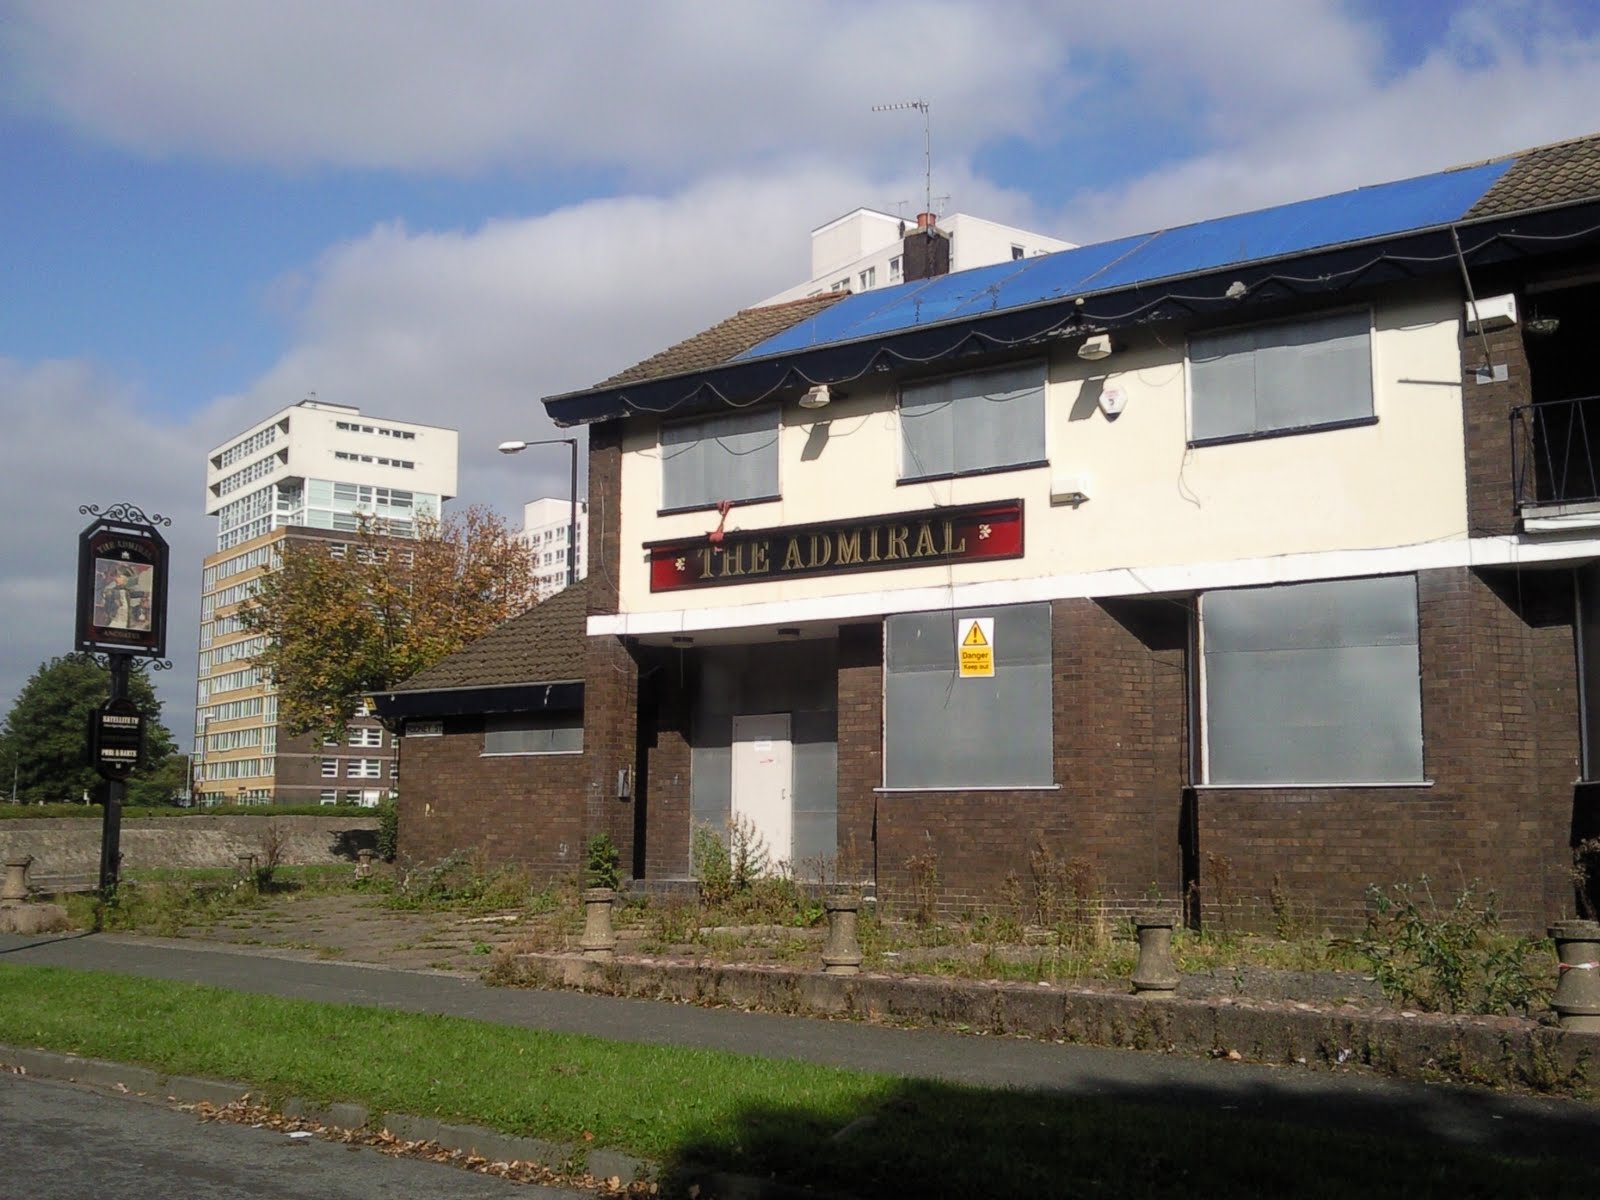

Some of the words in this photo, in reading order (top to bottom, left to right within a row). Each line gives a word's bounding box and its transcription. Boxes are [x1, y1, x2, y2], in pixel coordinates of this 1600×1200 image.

[698, 541, 771, 579] THE
[781, 519, 966, 571] ADMIRAL
[962, 652, 989, 660] Danger
